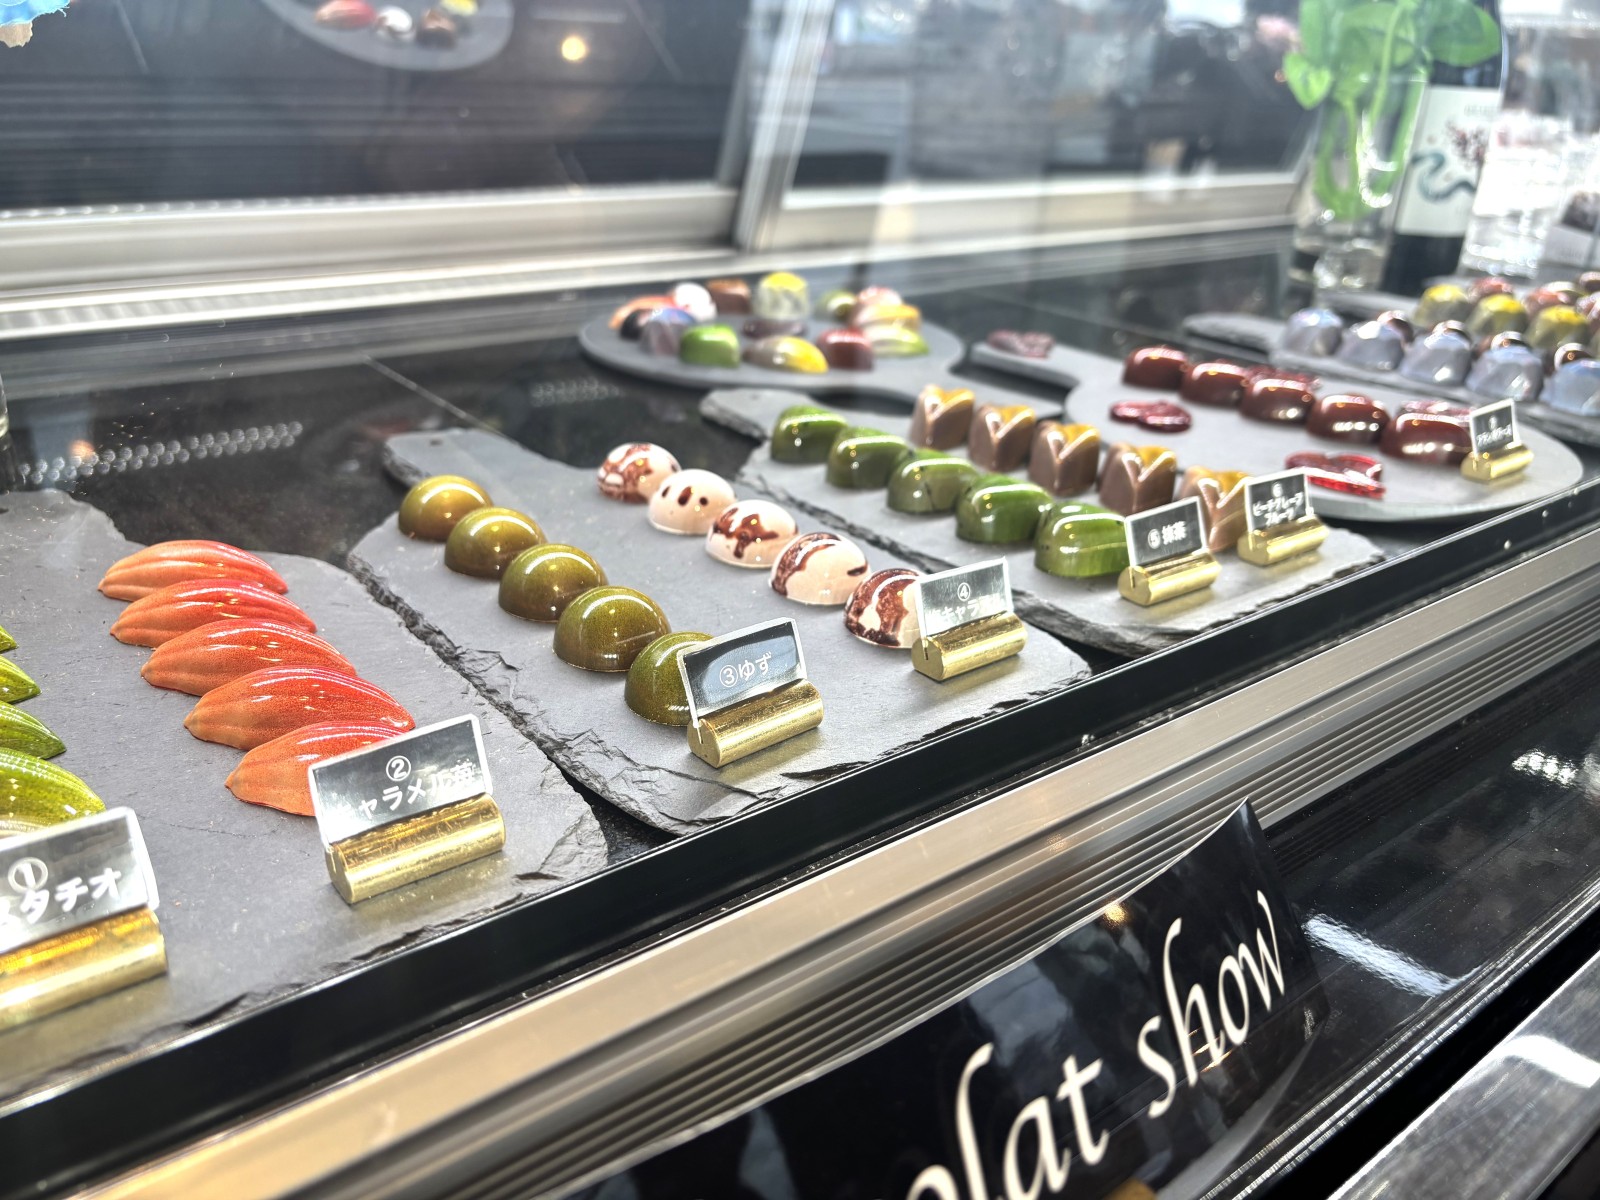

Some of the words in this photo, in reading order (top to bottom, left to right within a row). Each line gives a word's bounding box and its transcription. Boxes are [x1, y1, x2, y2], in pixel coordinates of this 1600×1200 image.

[334, 758, 477, 824] ャラメル苺
[1136, 890, 1285, 1118] show
